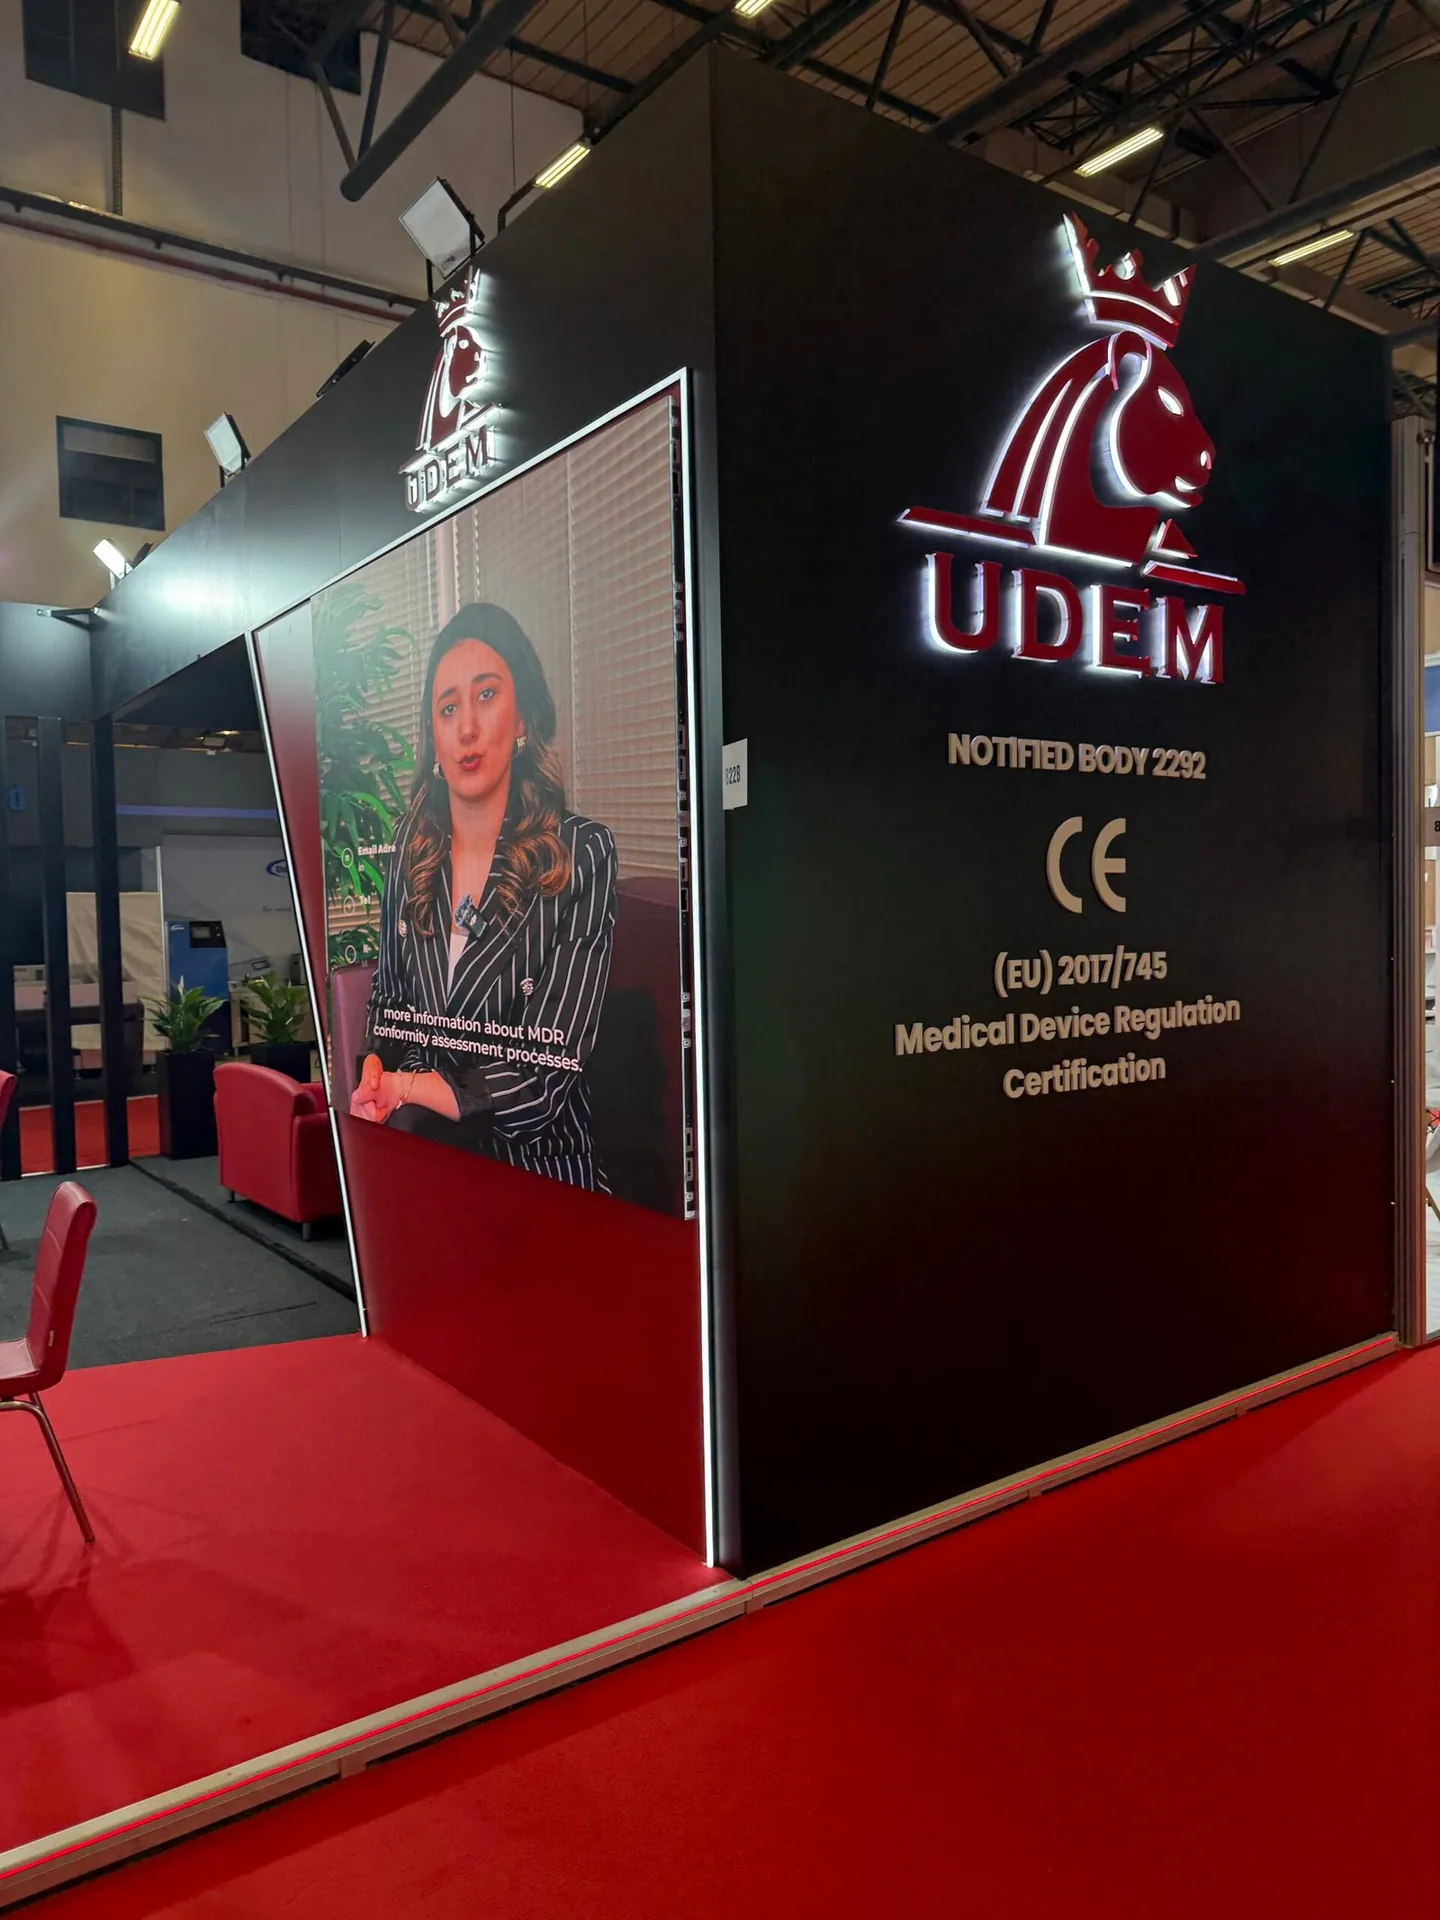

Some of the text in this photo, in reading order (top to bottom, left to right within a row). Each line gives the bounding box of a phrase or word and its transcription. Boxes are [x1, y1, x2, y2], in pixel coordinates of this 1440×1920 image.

[405, 424, 494, 511] UDEM
[926, 551, 1224, 684] UDEM
[948, 733, 1206, 780] NOTIFIED BODY 2292
[1046, 816, 1126, 913] CE
[994, 945, 1168, 998] (EU) 2017/745
[373, 1024, 583, 1072] conformity assessment processes.
[383, 1008, 565, 1046] more information about MDR
[894, 995, 1241, 1056] Medical Device Regulation
[1003, 1052, 1166, 1099] Certification
